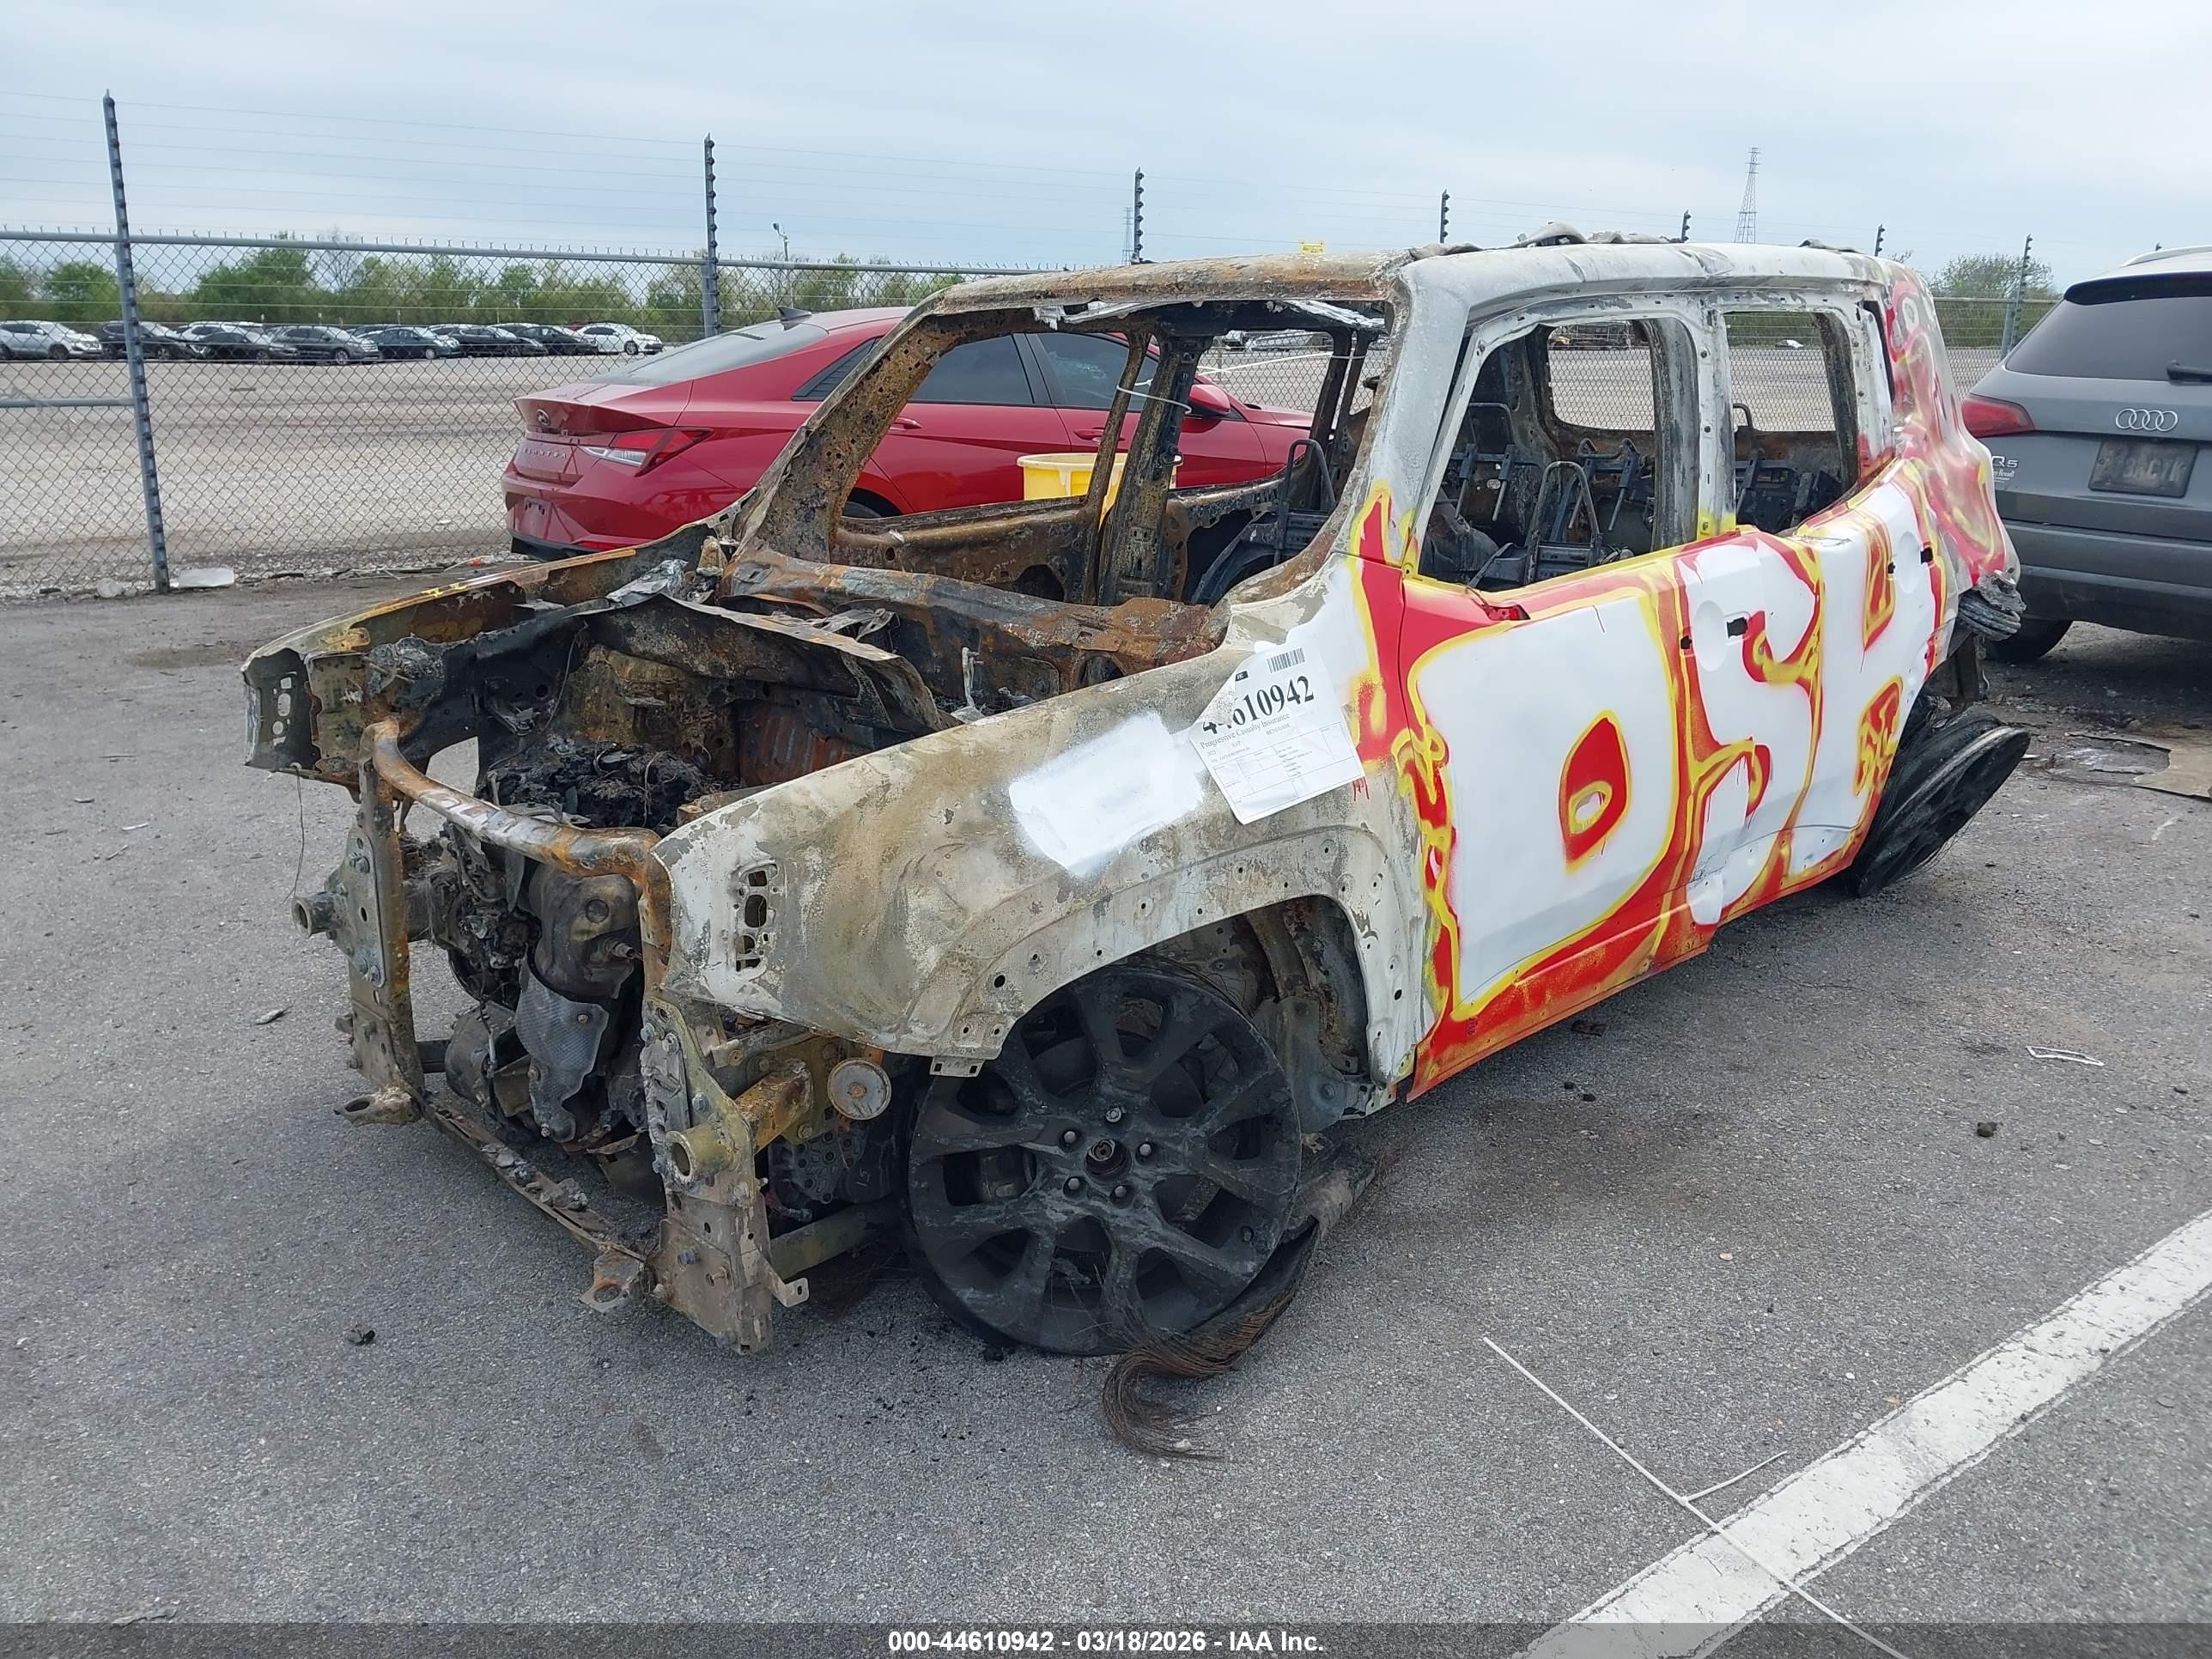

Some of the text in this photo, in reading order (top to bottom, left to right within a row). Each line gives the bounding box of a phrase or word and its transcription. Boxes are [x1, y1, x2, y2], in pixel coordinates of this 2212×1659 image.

[1991, 455, 2019, 468] Q5
[1200, 714, 1291, 750] Progressive Casualty Insurance
